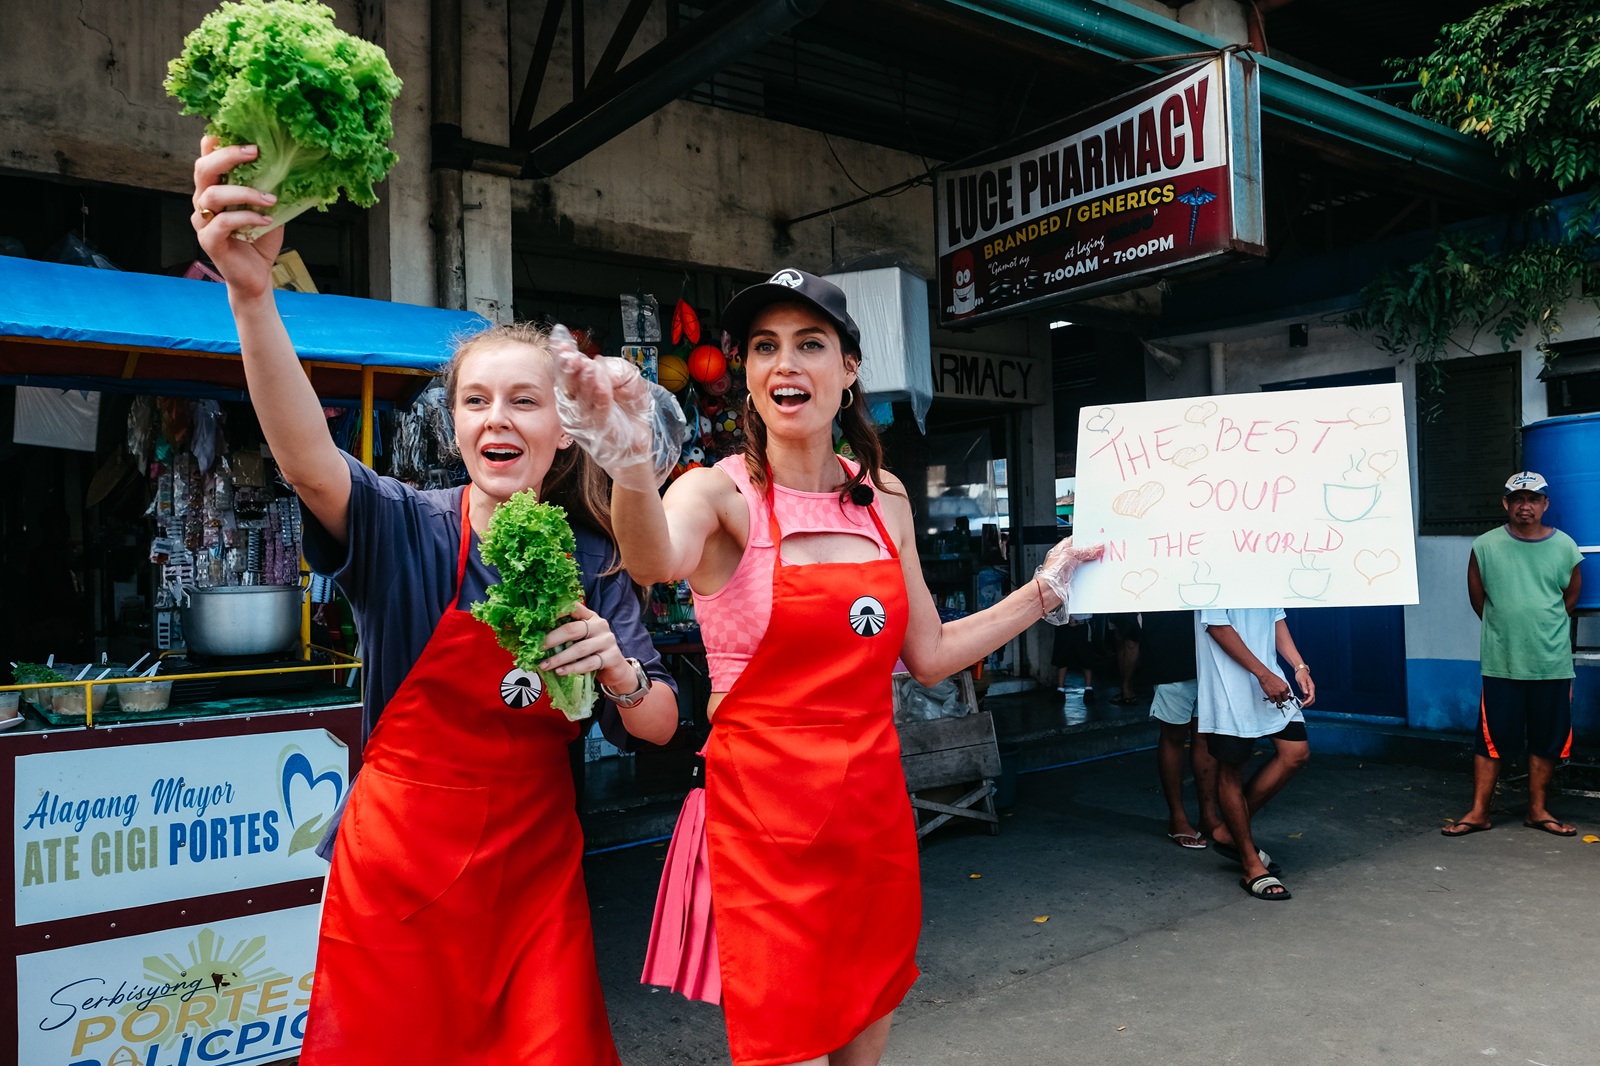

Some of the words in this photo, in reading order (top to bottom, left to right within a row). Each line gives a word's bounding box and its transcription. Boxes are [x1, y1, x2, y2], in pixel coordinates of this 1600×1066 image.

[946, 168, 1013, 247] LUCE
[1020, 74, 1209, 215] PHARMACY
[983, 215, 1060, 260] BRANDED
[1077, 184, 1175, 223] GENERICS
[1043, 256, 1099, 284] 7:00AM
[1113, 234, 1174, 262] 7:00PM
[1090, 425, 1182, 481] THE
[1216, 417, 1352, 454] BEST
[1187, 473, 1296, 512] SOUP
[1148, 531, 1206, 557] THE
[1232, 525, 1344, 554] WORLD
[23, 790, 140, 832] Alagang
[151, 776, 236, 817] Mayor
[22, 835, 80, 887] ATE
[91, 825, 158, 878] GIGI
[169, 809, 280, 866] PORTES
[39, 977, 218, 1031] Serbisyong
